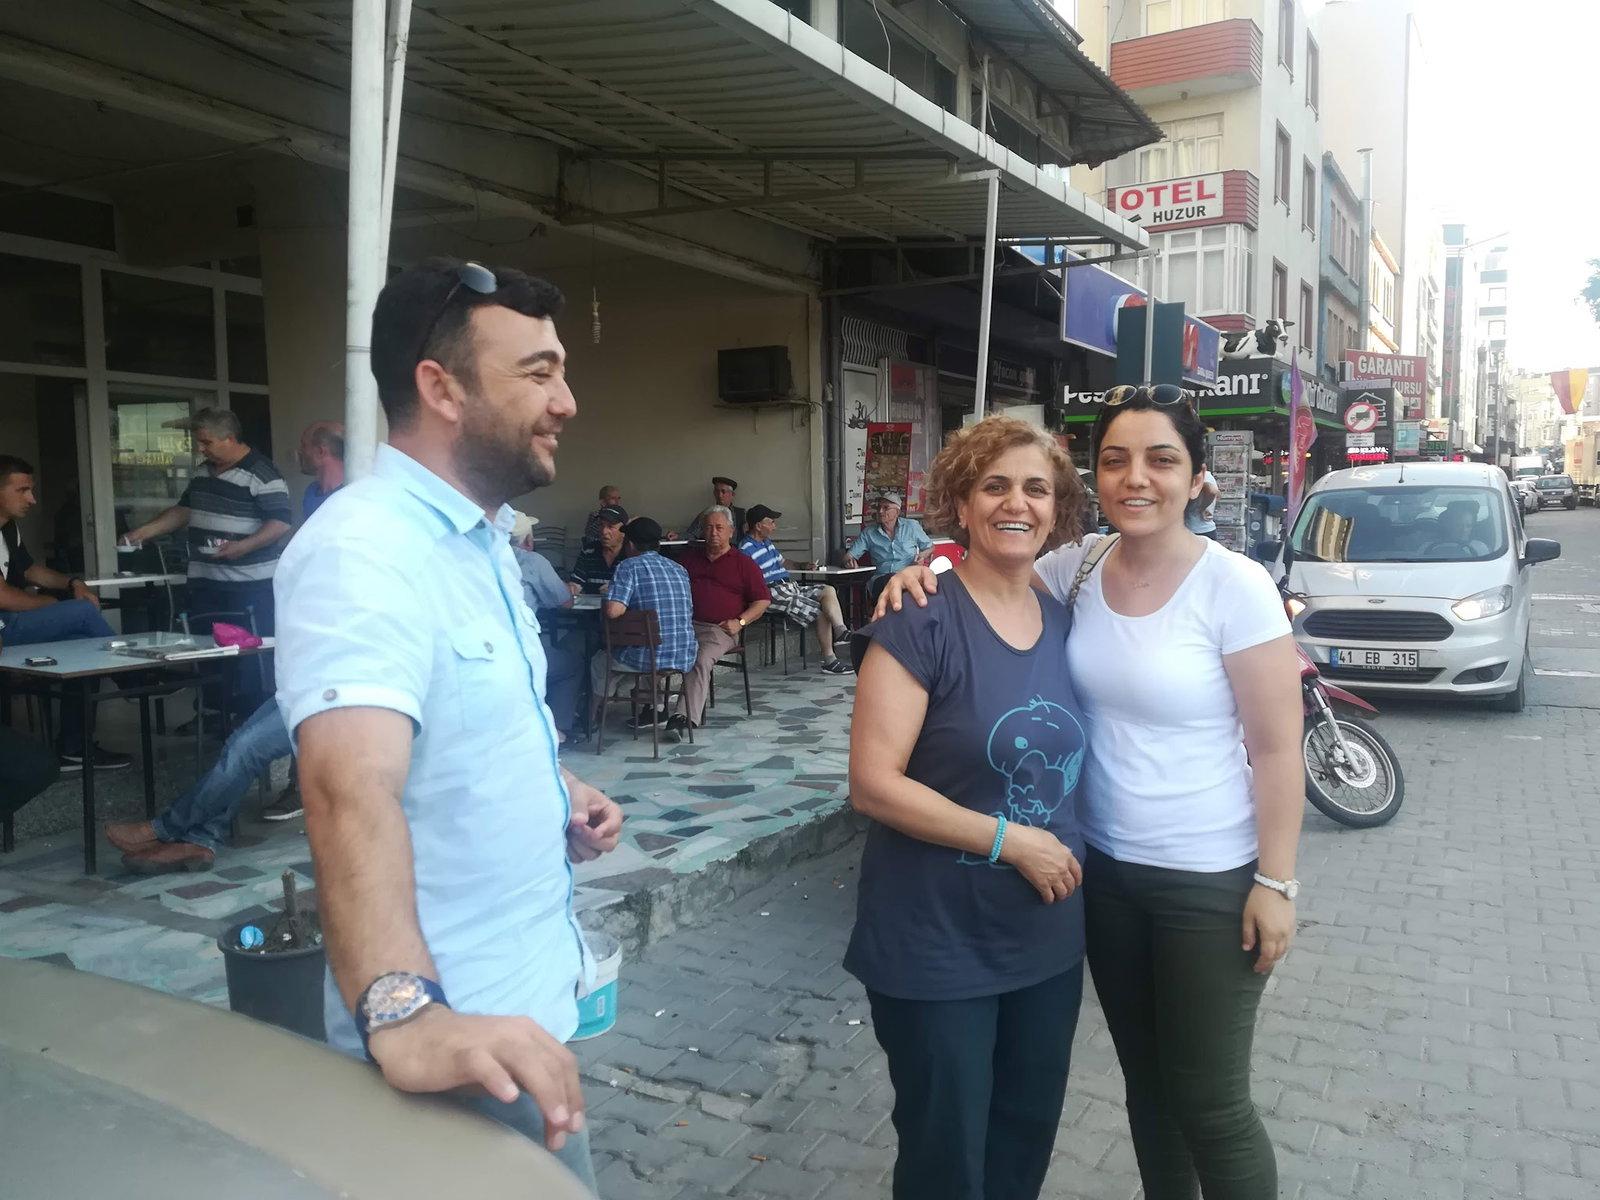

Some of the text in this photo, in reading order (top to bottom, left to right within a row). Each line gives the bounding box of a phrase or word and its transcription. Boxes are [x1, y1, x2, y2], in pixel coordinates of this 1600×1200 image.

[1120, 180, 1216, 210] OTEL
[1153, 205, 1207, 223] HUZUR
[1339, 651, 1417, 667] 41 EB 315
